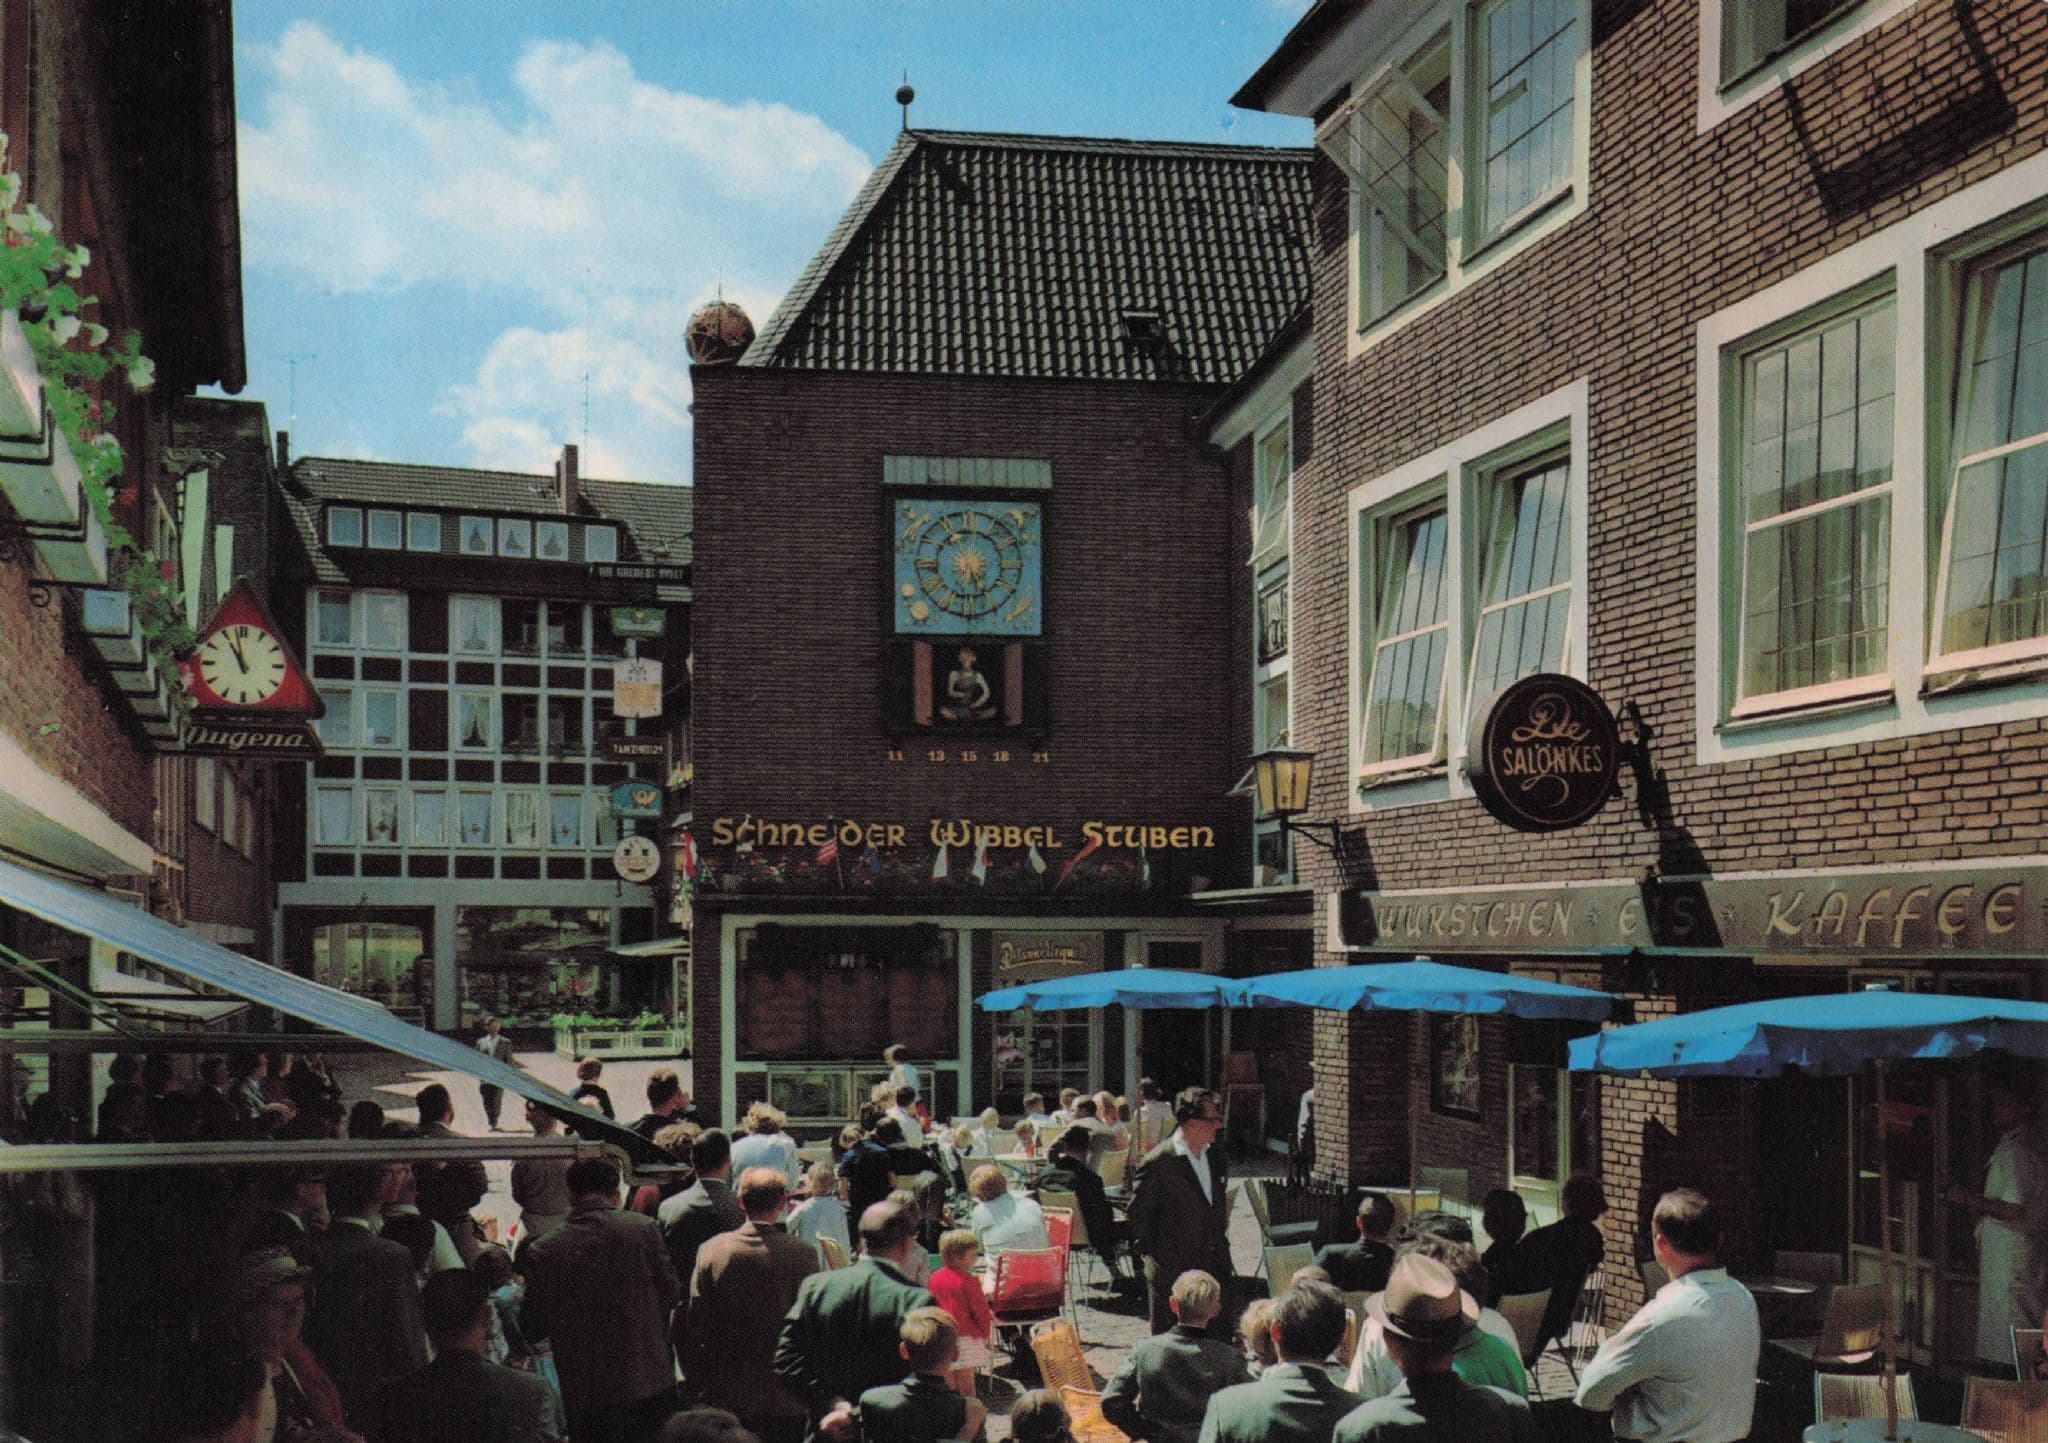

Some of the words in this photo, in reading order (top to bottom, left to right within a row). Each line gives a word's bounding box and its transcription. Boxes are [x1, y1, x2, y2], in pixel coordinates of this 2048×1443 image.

[887, 751, 904, 762] 11
[928, 751, 946, 762] 13
[962, 751, 978, 762] 15
[1033, 752, 1050, 763] 21
[1764, 881, 2024, 949] KAFFEE
